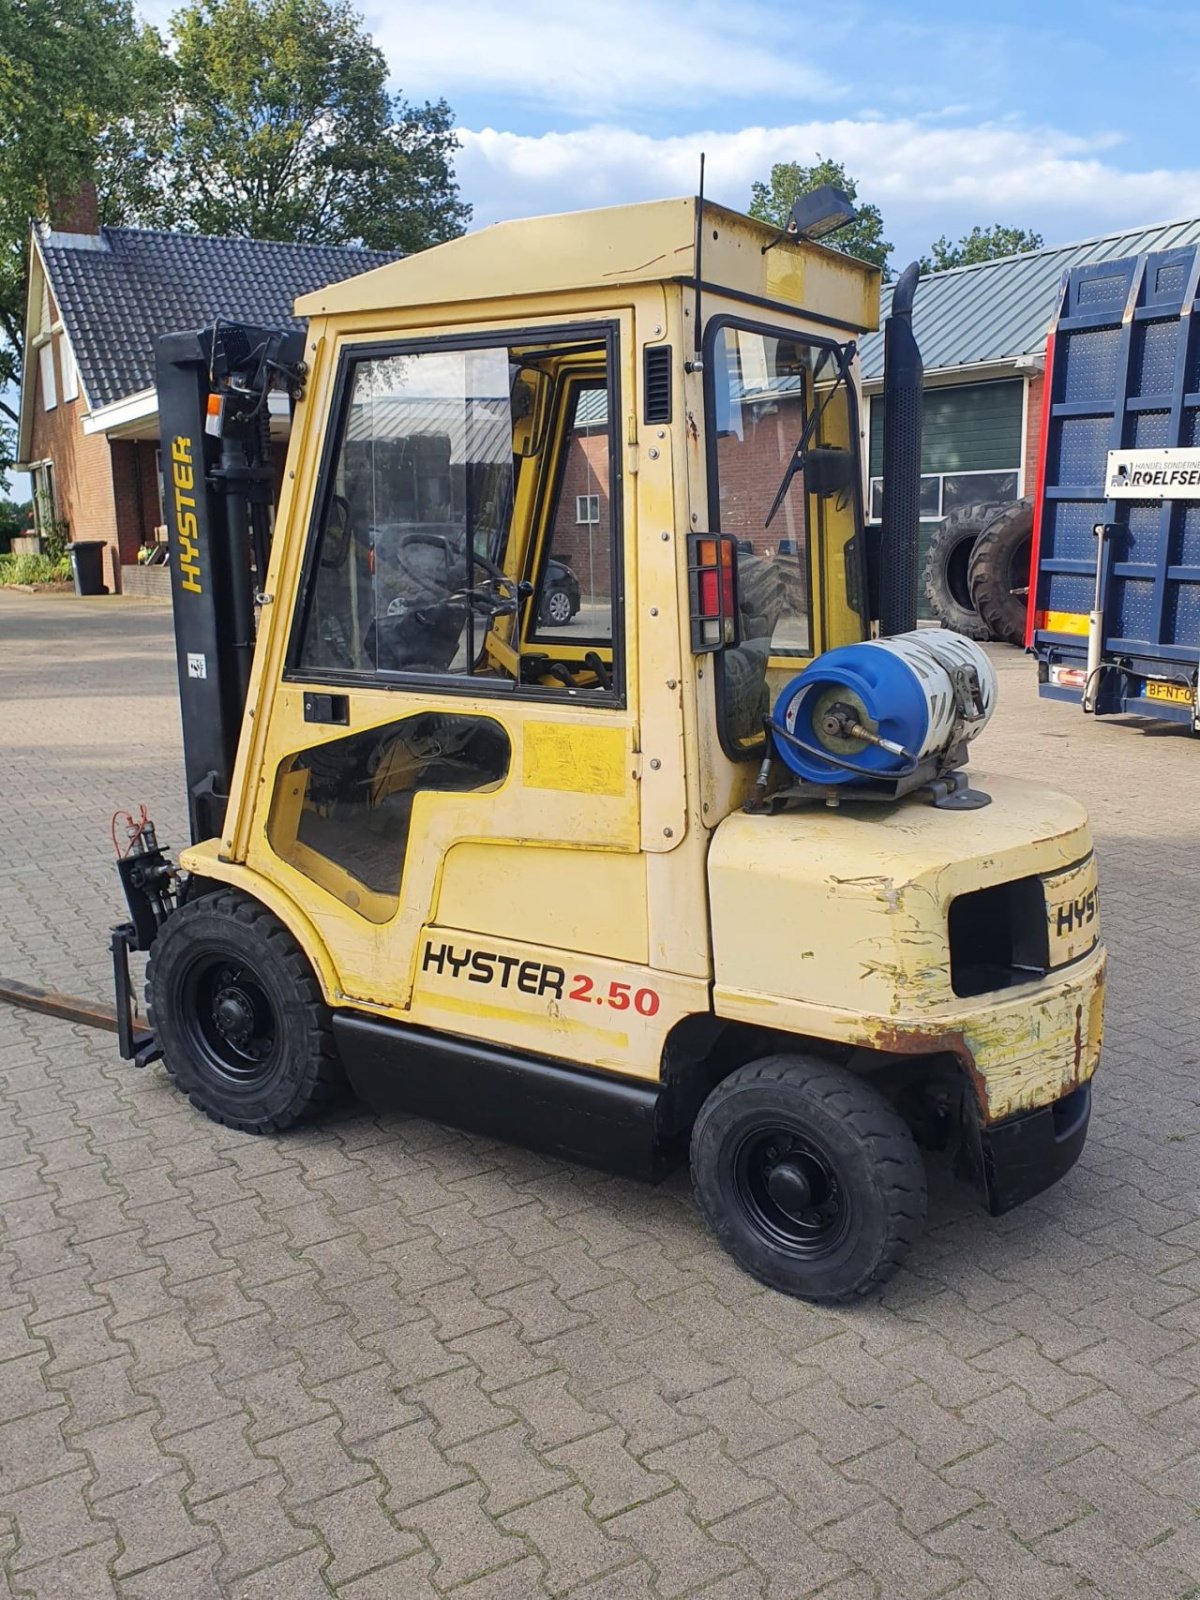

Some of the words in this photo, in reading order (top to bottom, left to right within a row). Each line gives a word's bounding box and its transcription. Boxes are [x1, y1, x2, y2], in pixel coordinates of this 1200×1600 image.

[171, 435, 202, 594] HYSTER
[422, 941, 566, 1000] HYSTER
[569, 974, 660, 1016] 2.50
